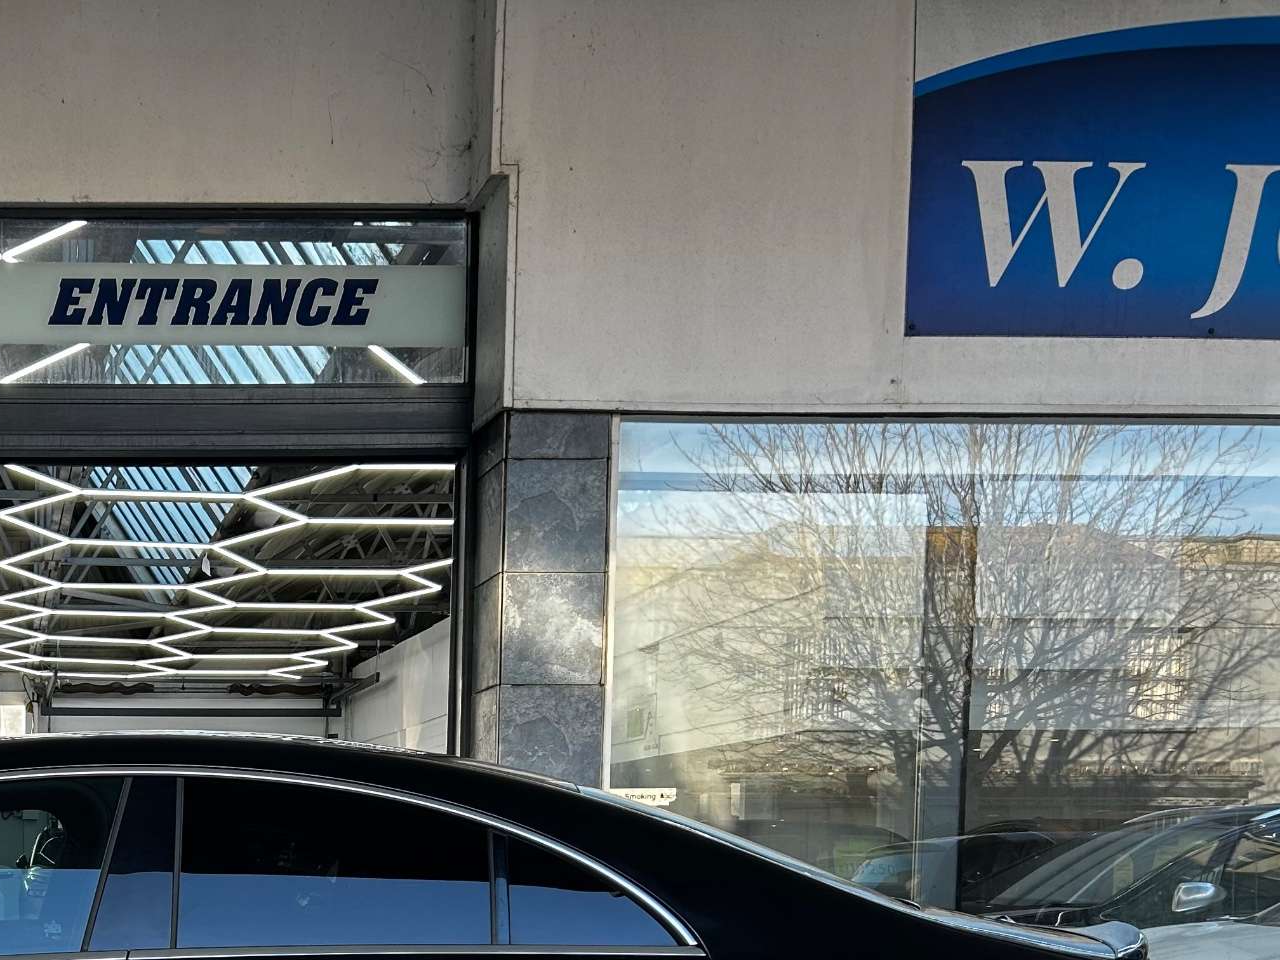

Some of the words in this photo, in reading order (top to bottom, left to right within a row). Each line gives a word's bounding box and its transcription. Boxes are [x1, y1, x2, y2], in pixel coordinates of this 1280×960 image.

[961, 160, 1147, 290] W.
[1190, 164, 1280, 319] J
[48, 278, 379, 327] ENTRANCE
